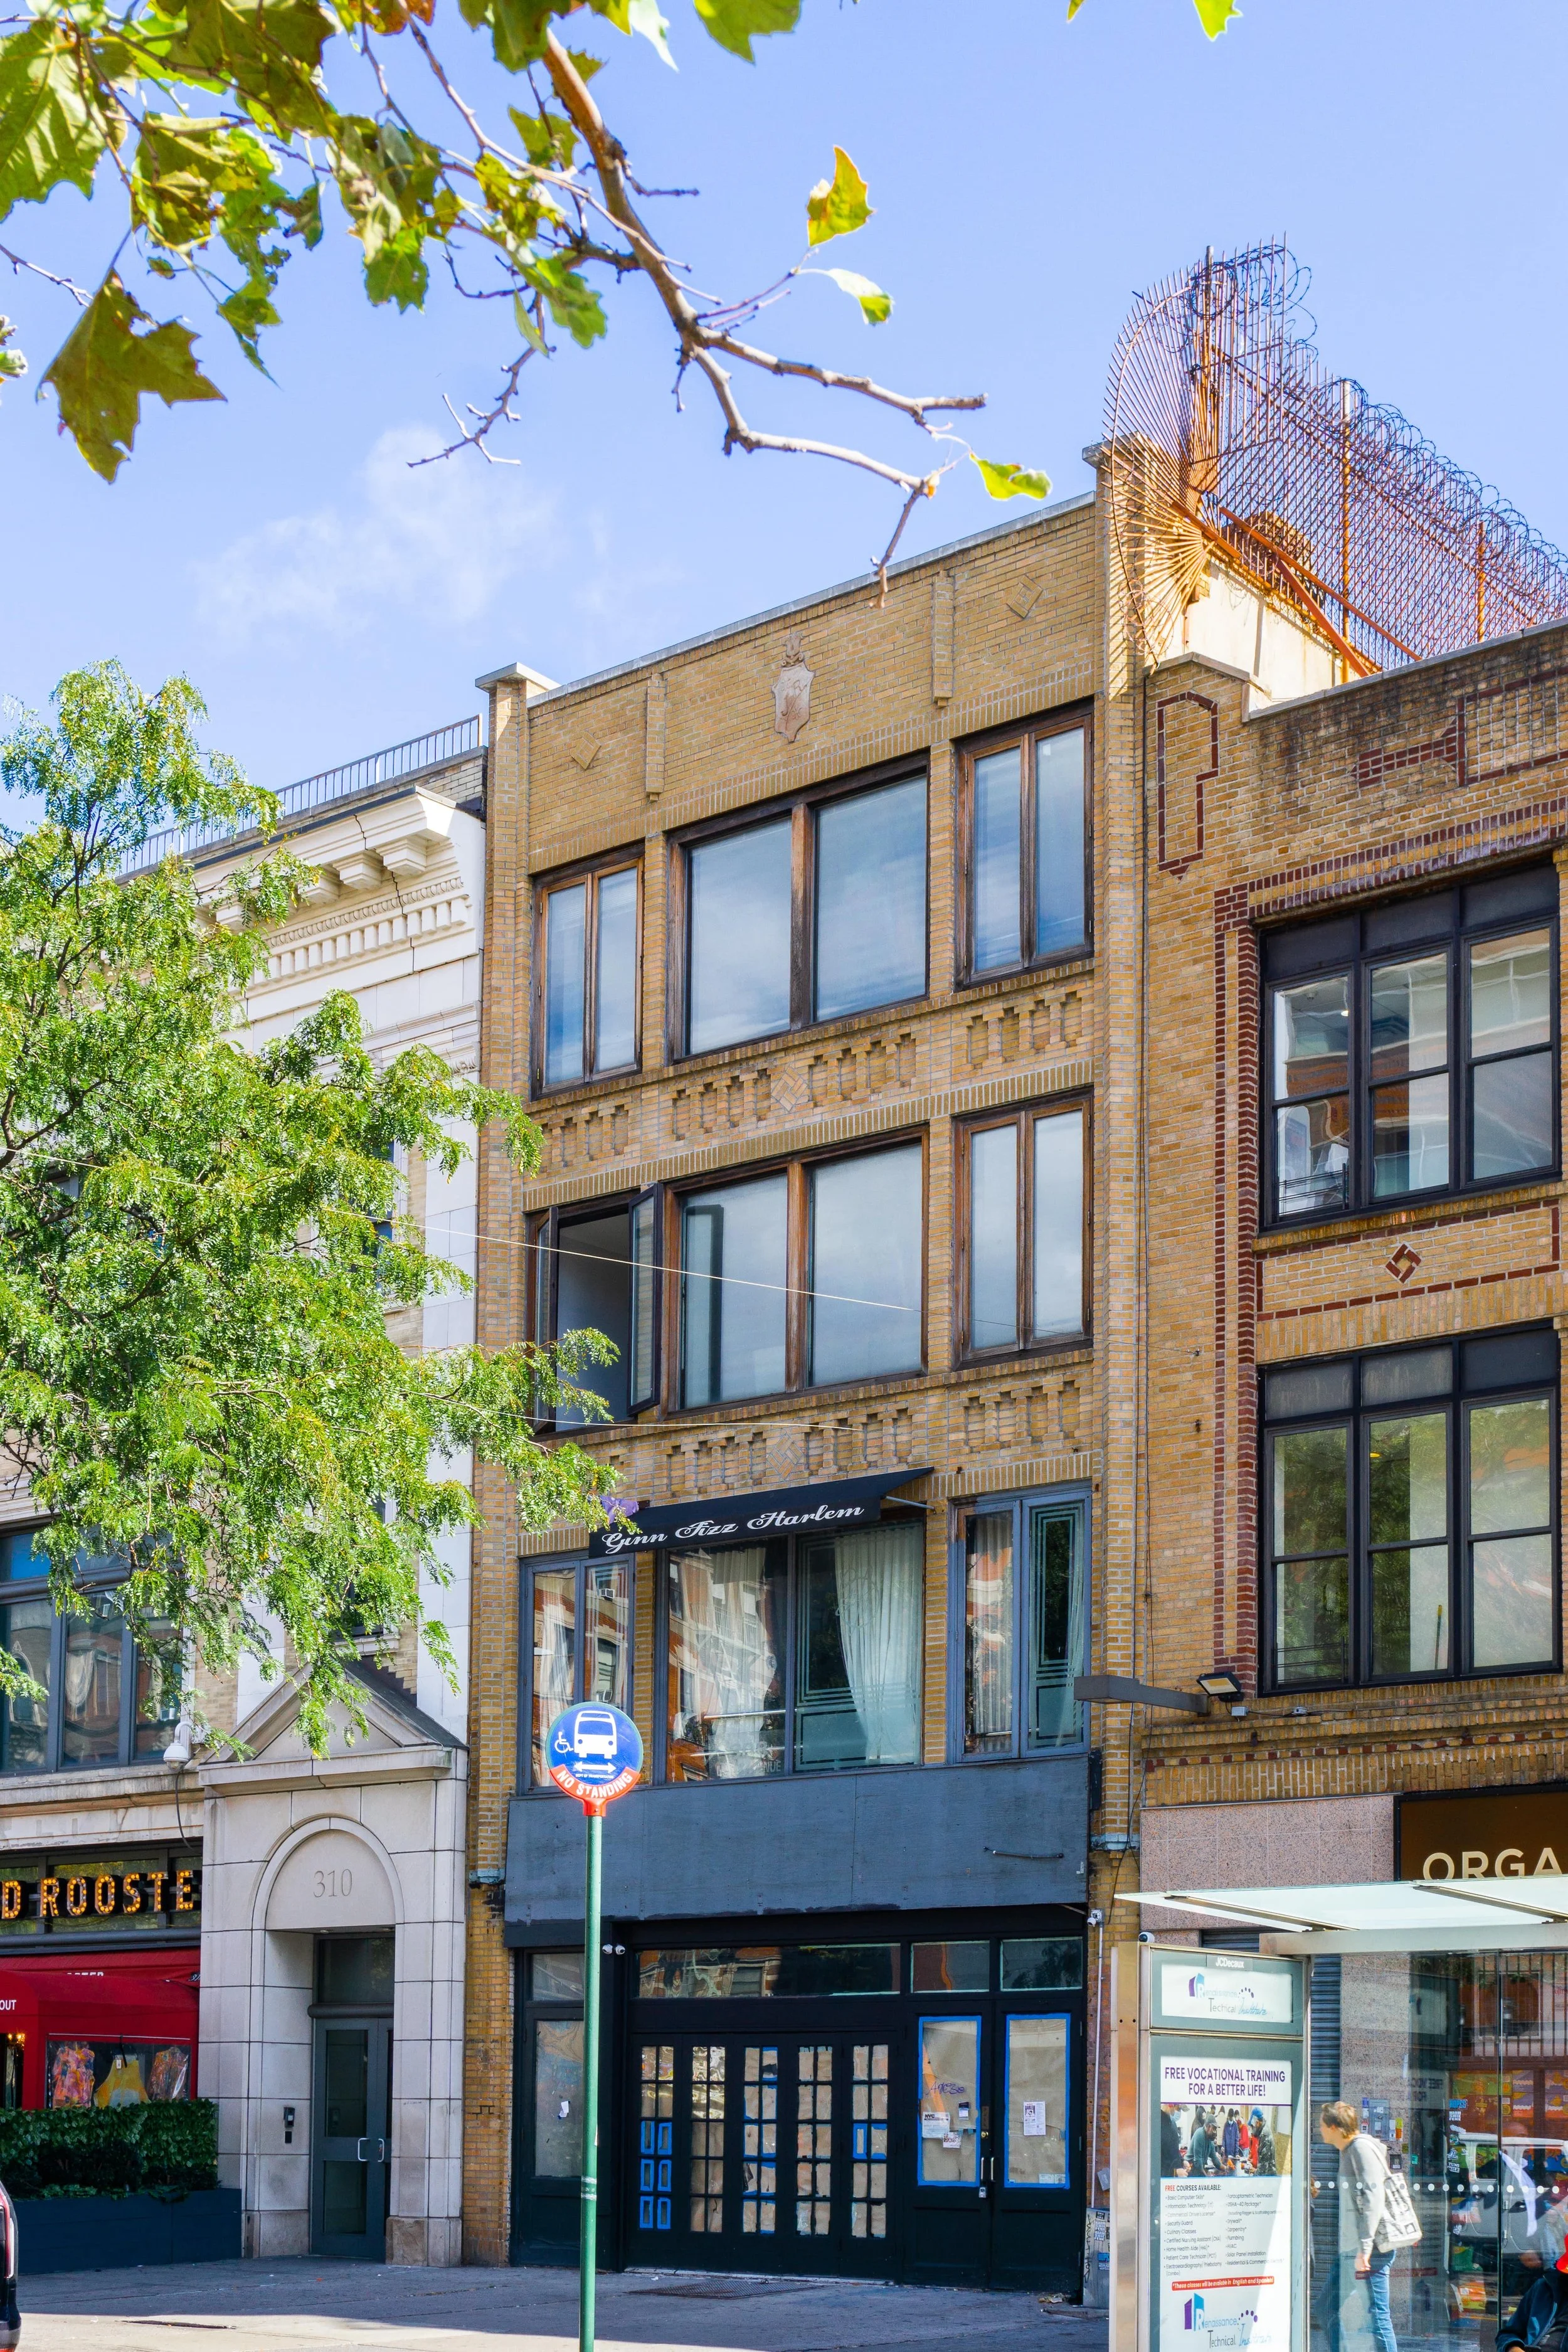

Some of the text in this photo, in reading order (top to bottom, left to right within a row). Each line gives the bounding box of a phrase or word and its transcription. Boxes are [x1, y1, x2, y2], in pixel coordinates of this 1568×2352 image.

[675, 1520, 739, 1538] Fizz
[747, 1505, 864, 1530] Harlem
[556, 1770, 633, 1798] NO STANDING
[1422, 1847, 1562, 1880] ORGA
[314, 1868, 352, 1897] 310
[1216, 1957, 1244, 1968] JCDecaux
[1165, 2067, 1285, 2082] FREE VOCATIONAL TRAINING
[1189, 2083, 1266, 2097] FOR A BETTER LIFE!
[1207, 2330, 1236, 2348] Technical
